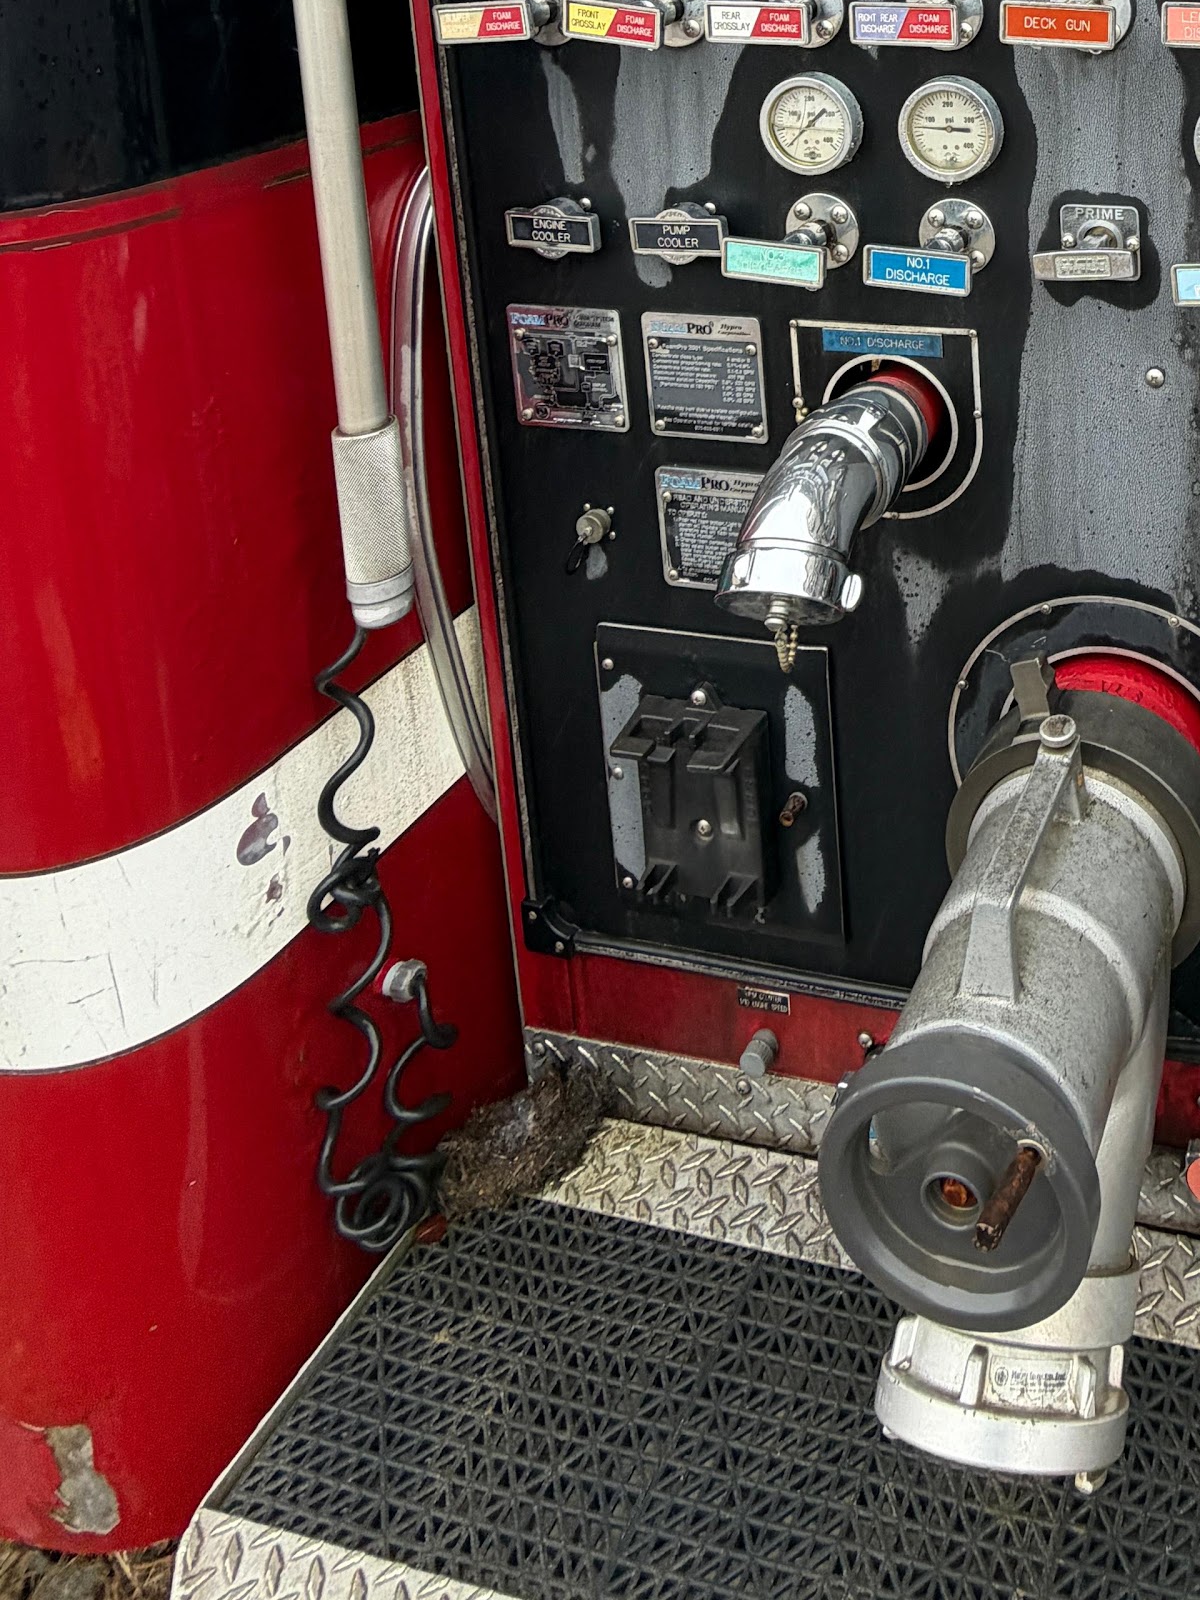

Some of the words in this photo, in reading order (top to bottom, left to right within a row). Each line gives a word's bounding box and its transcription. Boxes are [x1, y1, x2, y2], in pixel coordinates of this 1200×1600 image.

[492, 11, 512, 20] FOAM
[577, 8, 599, 19] FRONT
[721, 11, 741, 21] REAR
[769, 12, 790, 22] FOAM
[857, 13, 877, 23] RIGHT
[880, 13, 898, 23] REAR
[918, 13, 940, 23] FOAM
[486, 20, 521, 31] DISCHARGE
[571, 18, 606, 31] CROSSLAY
[625, 15, 645, 25] FOAM
[1023, 16, 1057, 30] DECK
[1065, 19, 1091, 32] GUN
[616, 23, 653, 38] DISCHARGE
[713, 21, 751, 32] CROSSLAY
[760, 22, 799, 35] DISCHARGE
[860, 23, 896, 34] DISCHARGE
[908, 23, 950, 35] DISCHARGE
[963, 116, 975, 124] 300
[1074, 207, 1125, 221] PRIME
[532, 218, 567, 231] ENGINE
[662, 225, 691, 235] PUMP
[531, 231, 571, 243] COOLER
[657, 237, 699, 248] COOLER
[906, 256, 931, 271] NO.1
[885, 269, 951, 286] DISCHARGE
[839, 336, 861, 347] NO.1
[866, 337, 926, 351] DISCHARGE
